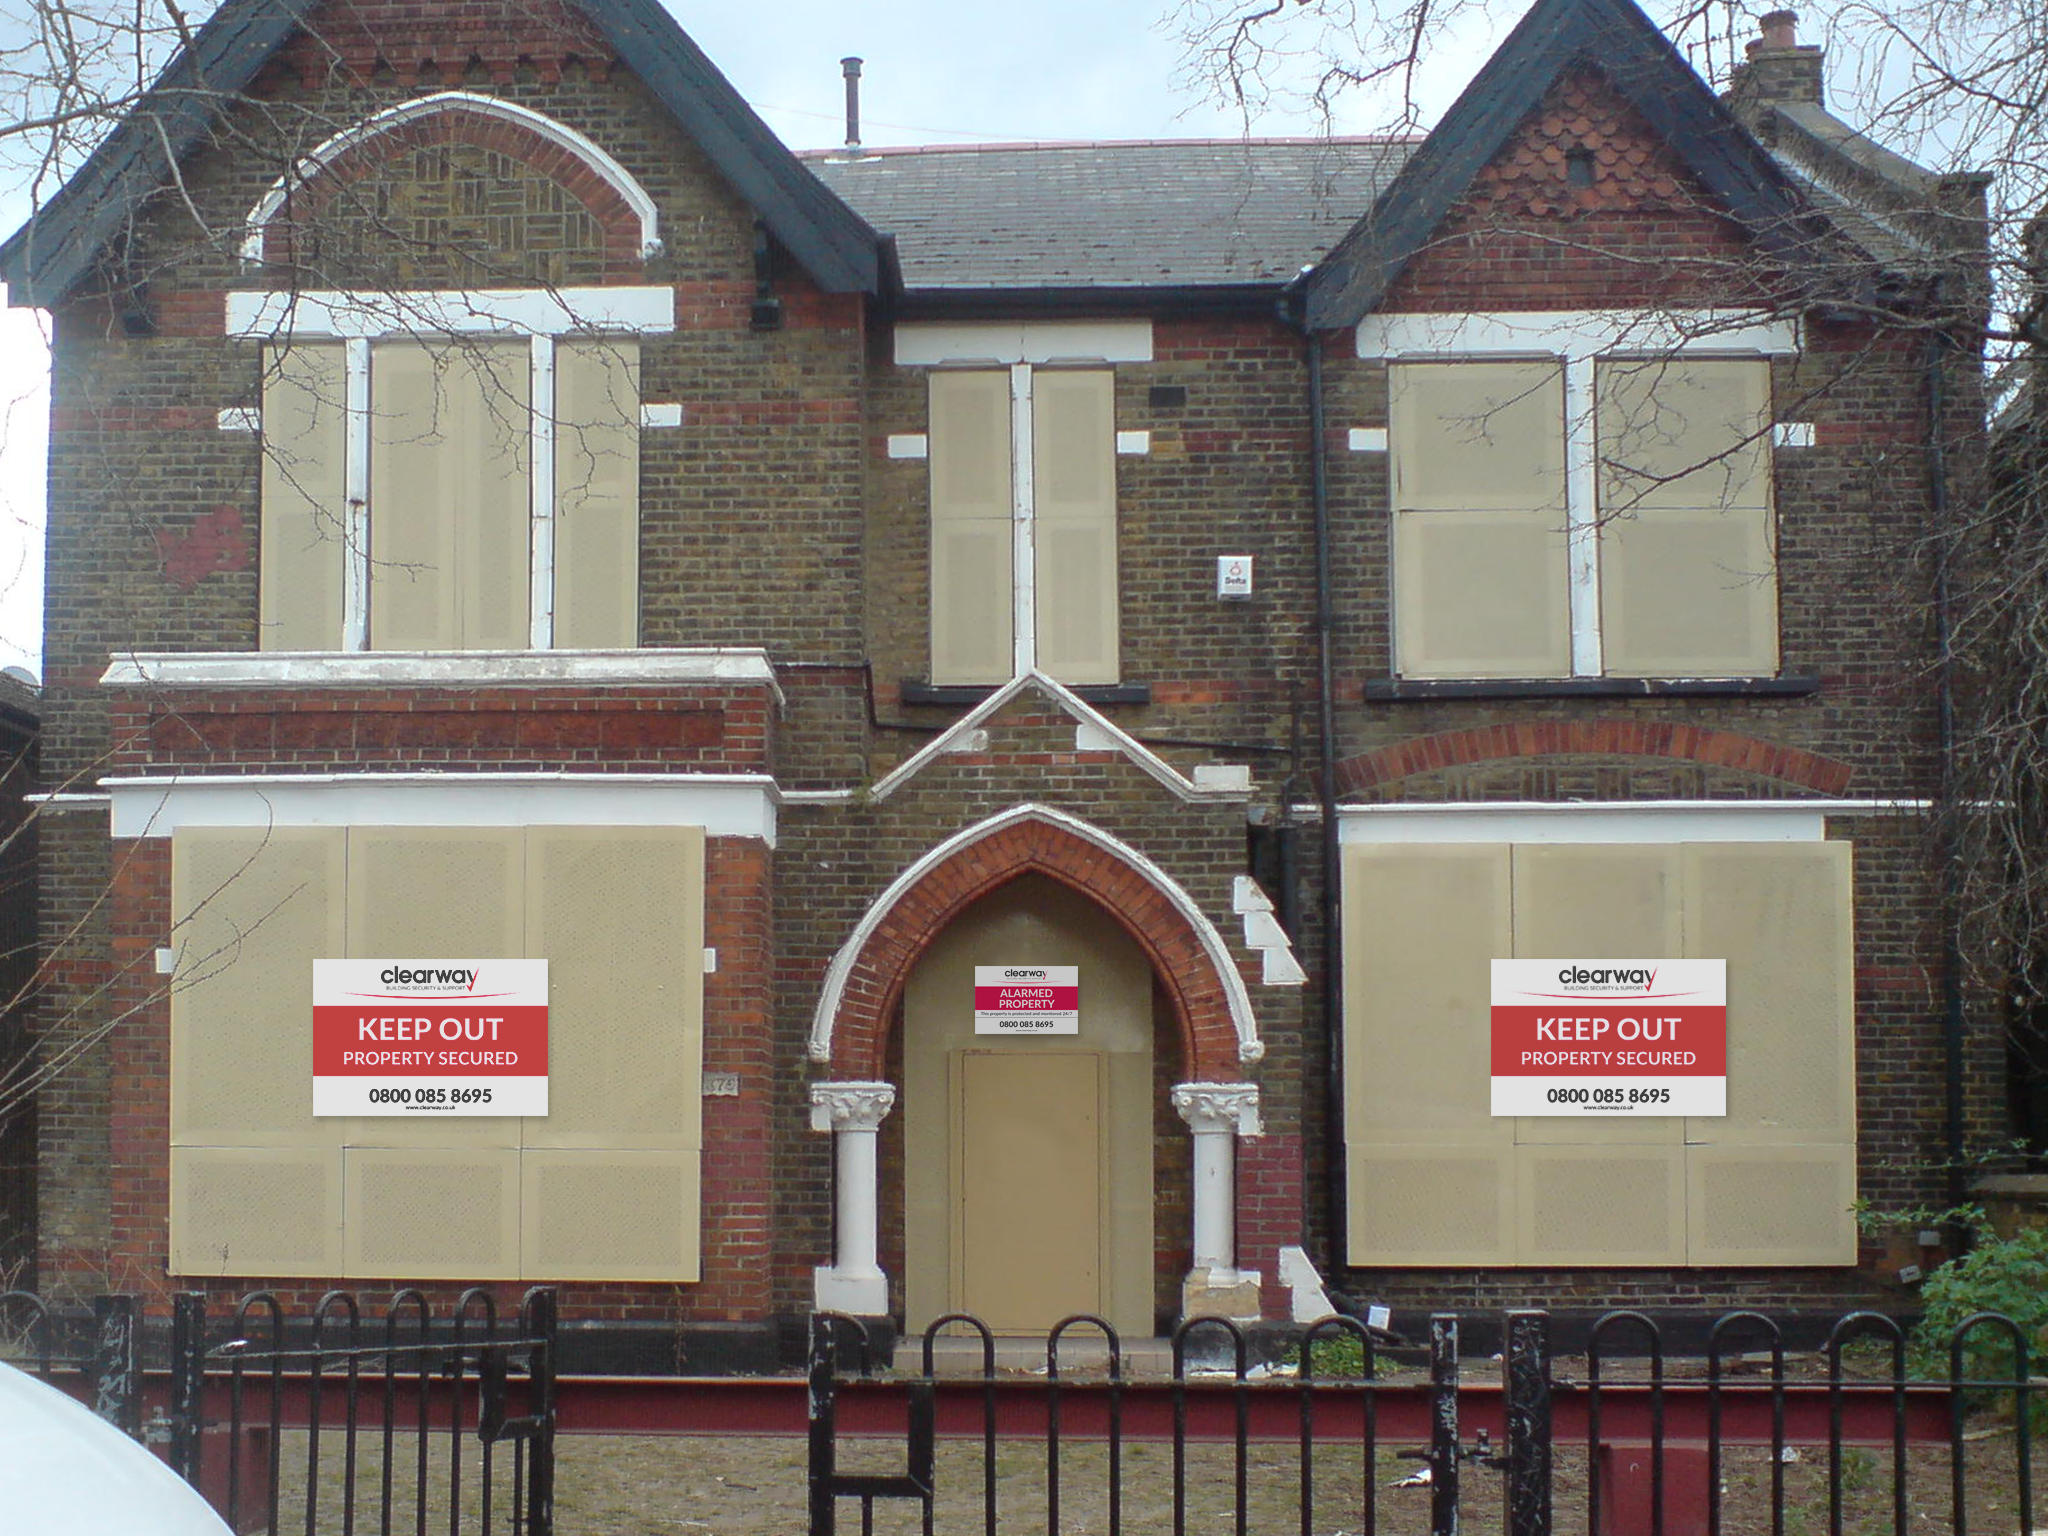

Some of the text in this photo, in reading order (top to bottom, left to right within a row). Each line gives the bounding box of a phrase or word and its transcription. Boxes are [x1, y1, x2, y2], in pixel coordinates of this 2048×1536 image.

[380, 965, 480, 992] clearway
[1004, 968, 1048, 981] clearway
[1558, 965, 1658, 992] clearway
[999, 988, 1053, 998] ALARMED
[998, 999, 1055, 1009] PROPERTY
[358, 1017, 504, 1041] KEEP OUT
[999, 1020, 1054, 1028] 0800 085 8695
[1536, 1017, 1682, 1041] KEEP OUT
[343, 1050, 518, 1066] PROPERTY SECURED
[1521, 1050, 1696, 1066] PROPERTY SECURED
[369, 1088, 492, 1104] 0800 085 8695
[1547, 1088, 1670, 1104] 0800 085 8695
